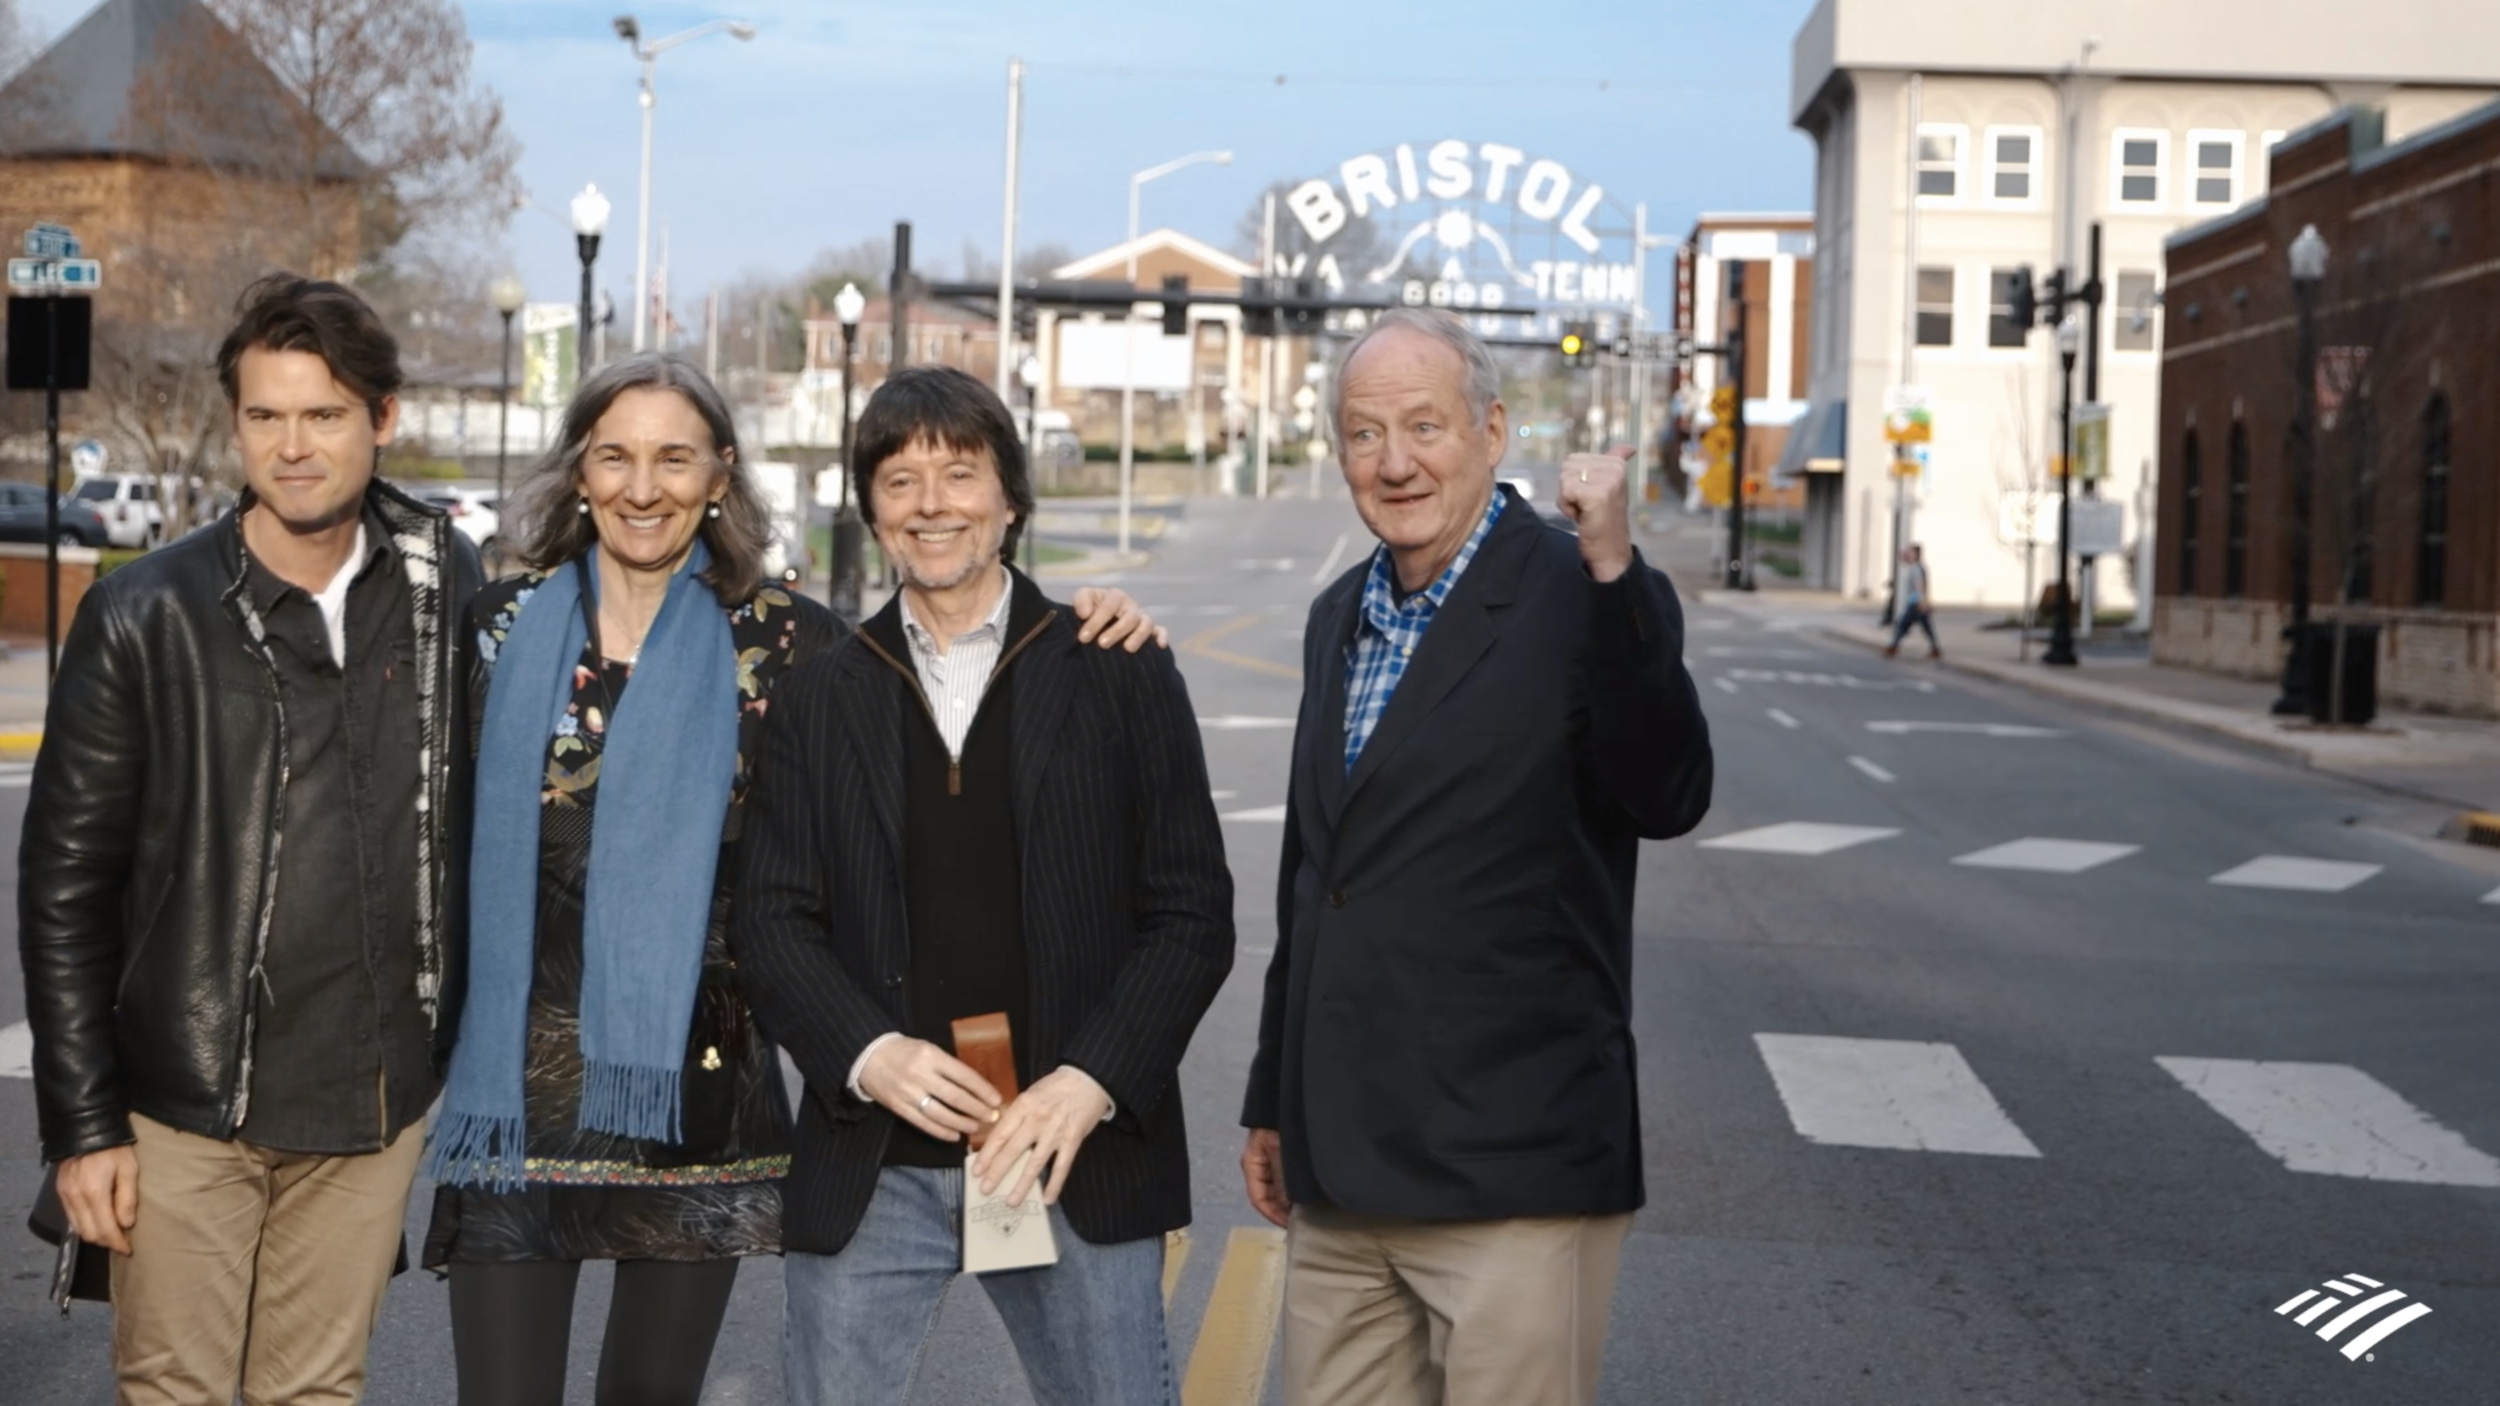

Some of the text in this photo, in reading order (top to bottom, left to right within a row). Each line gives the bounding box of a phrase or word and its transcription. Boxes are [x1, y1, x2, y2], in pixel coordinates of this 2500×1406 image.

[1286, 139, 1603, 254] BRISTOL
[1441, 256, 1465, 283] A
[1531, 260, 1636, 301] TENN
